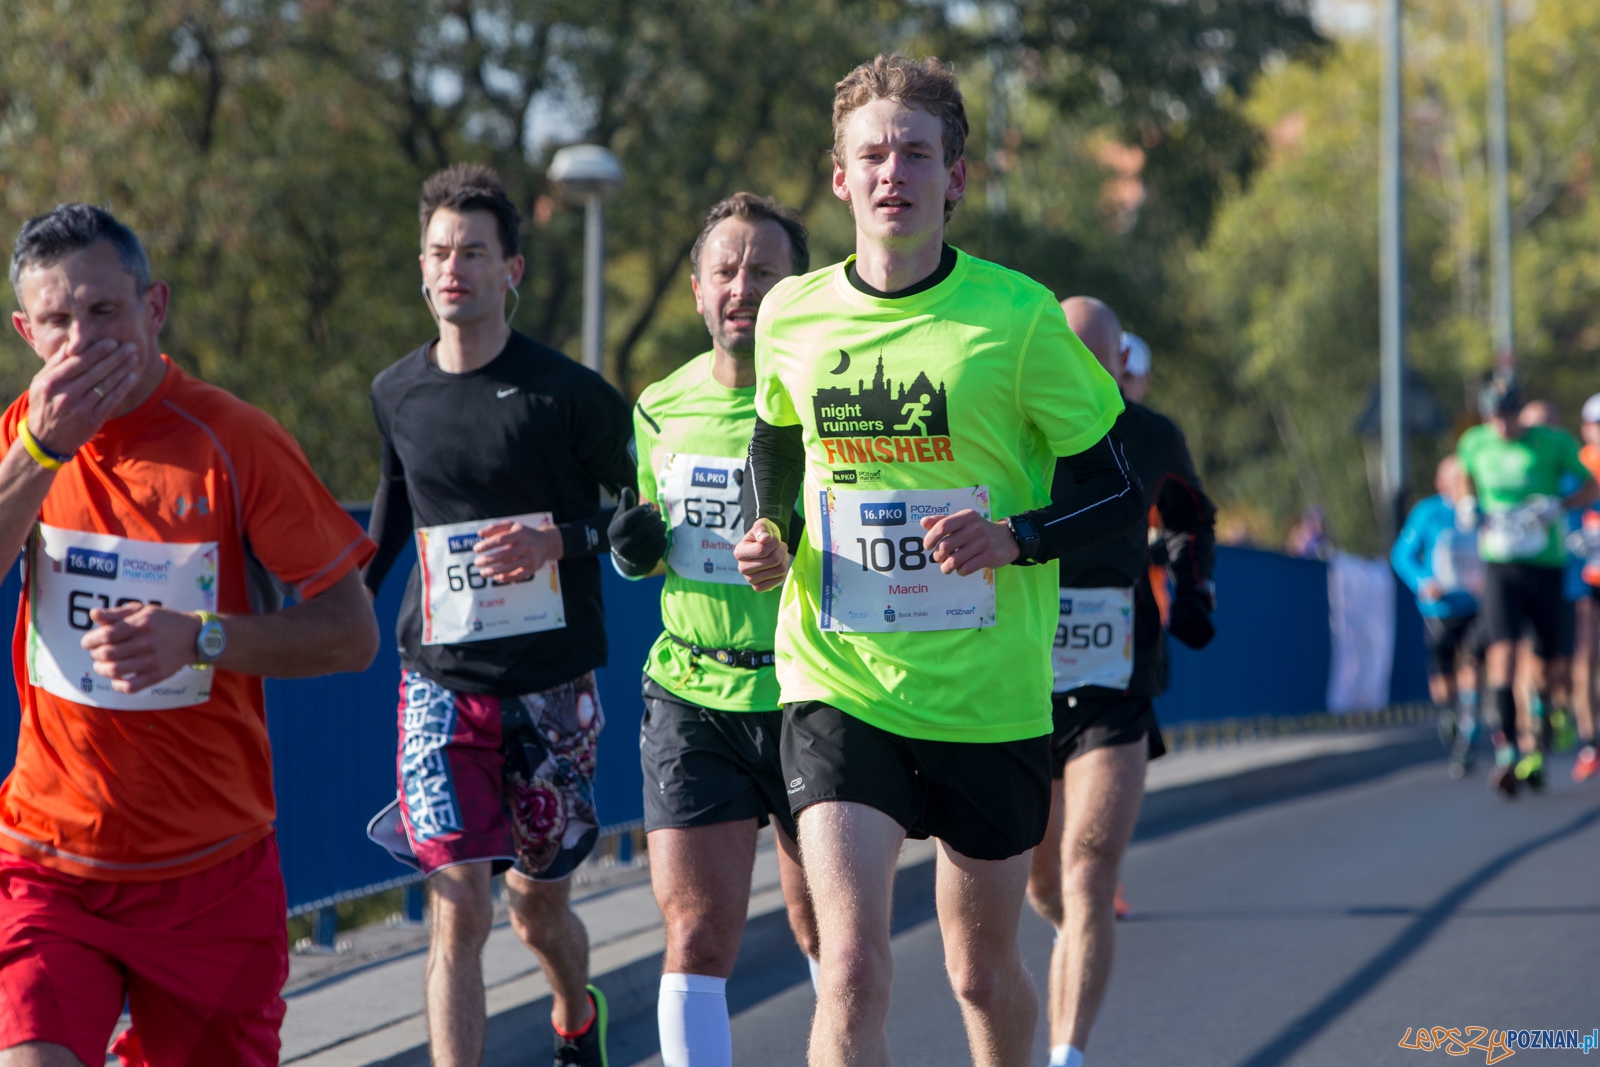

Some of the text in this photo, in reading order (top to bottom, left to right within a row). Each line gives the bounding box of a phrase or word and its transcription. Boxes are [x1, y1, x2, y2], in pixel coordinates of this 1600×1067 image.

[821, 404, 861, 420] night
[823, 420, 884, 432] runners
[821, 436, 955, 464] FINISHER
[695, 472, 706, 482] 16.
[707, 474, 726, 484] PKO
[863, 510, 877, 519] 16.
[879, 508, 903, 519] PKO
[857, 536, 938, 572] 108
[70, 554, 114, 573] 16. PKO
[122, 569, 168, 581] maraton
[447, 562, 535, 592] 66
[889, 584, 928, 594] Marcin
[479, 598, 505, 608] Kamil
[913, 610, 929, 618] Polski
